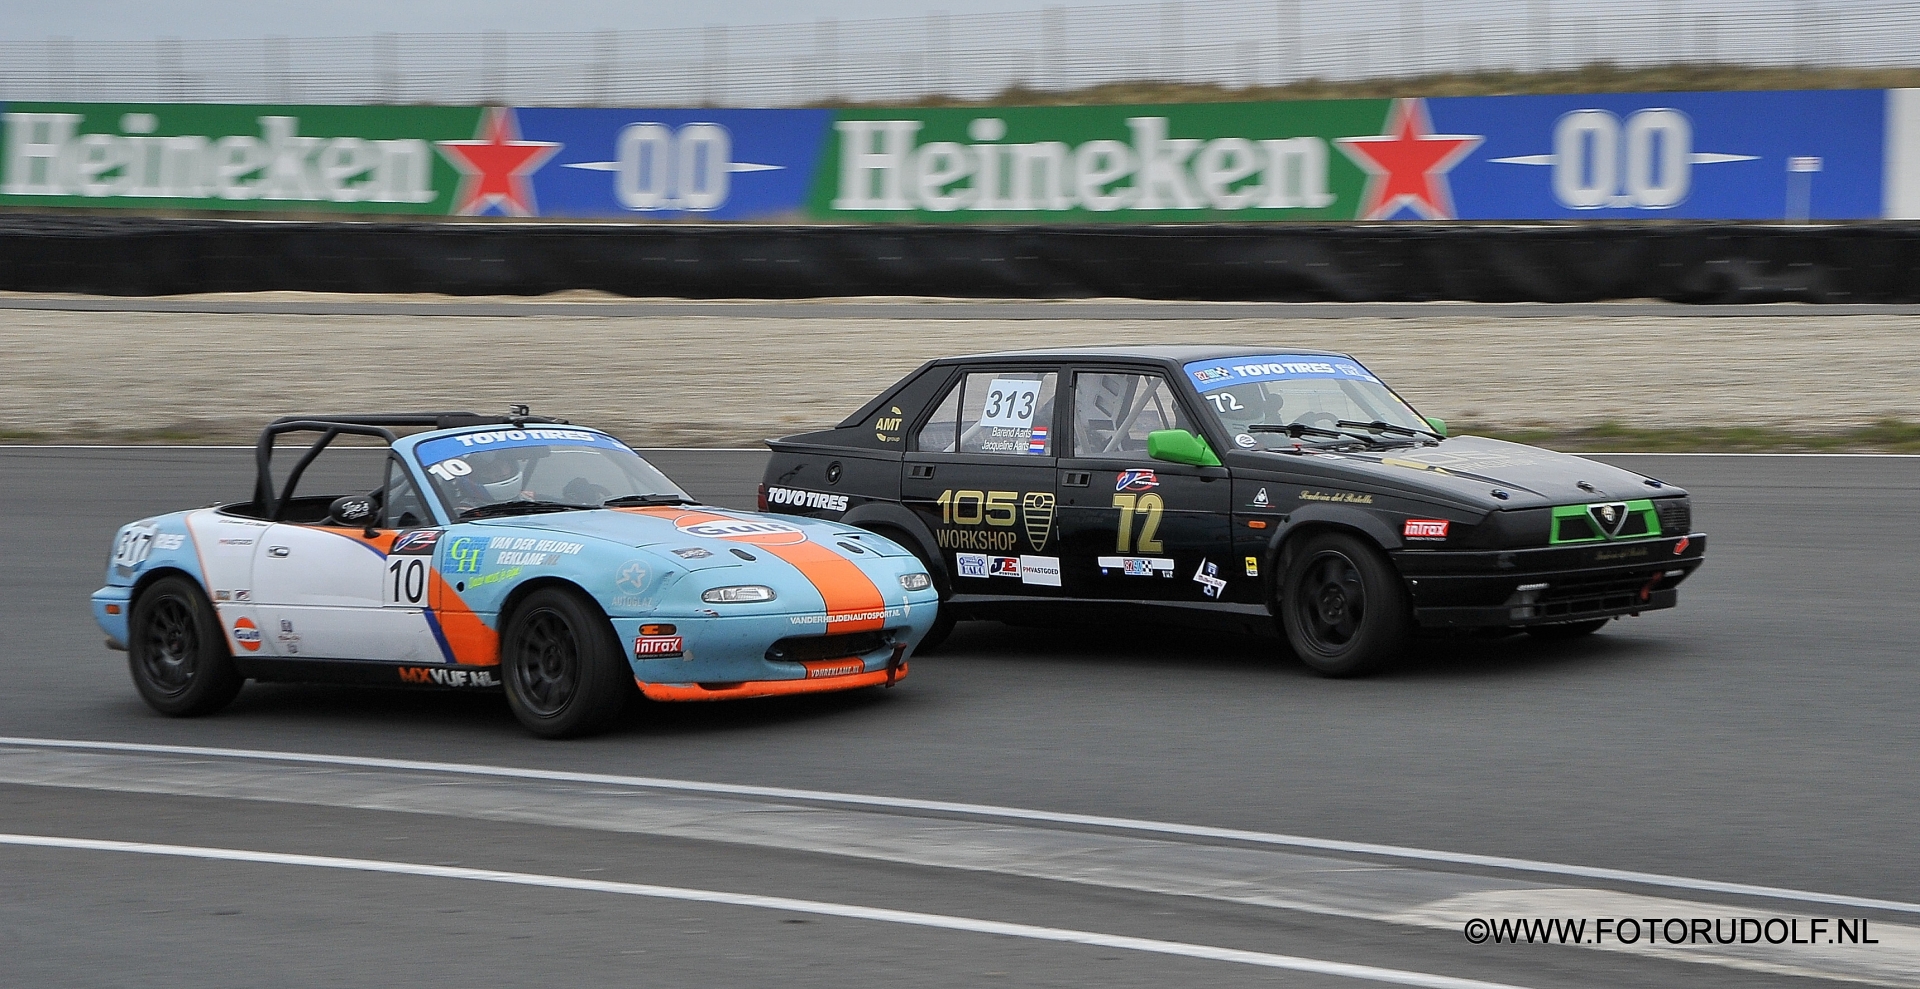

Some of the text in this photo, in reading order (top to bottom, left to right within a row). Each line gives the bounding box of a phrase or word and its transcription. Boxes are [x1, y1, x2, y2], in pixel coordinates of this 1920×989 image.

[4, 112, 438, 203] Heineken
[834, 116, 1335, 211] Heineken
[985, 390, 1035, 420] 313
[1206, 392, 1244, 413] 72
[875, 418, 902, 431] AMT
[991, 426, 1032, 438] Barend Aarts
[1013, 441, 1030, 451] Aarts
[427, 459, 473, 481] 10
[937, 489, 1019, 526] 105
[687, 522, 795, 536] Gulf
[1112, 492, 1164, 555] 72
[115, 530, 154, 565] 317
[489, 536, 584, 555] VAN DER HEIJDEN
[937, 529, 1017, 551] WORKSHOP
[991, 557, 1017, 573] JE
[389, 558, 425, 604] 10
[636, 638, 681, 653] inTrax
